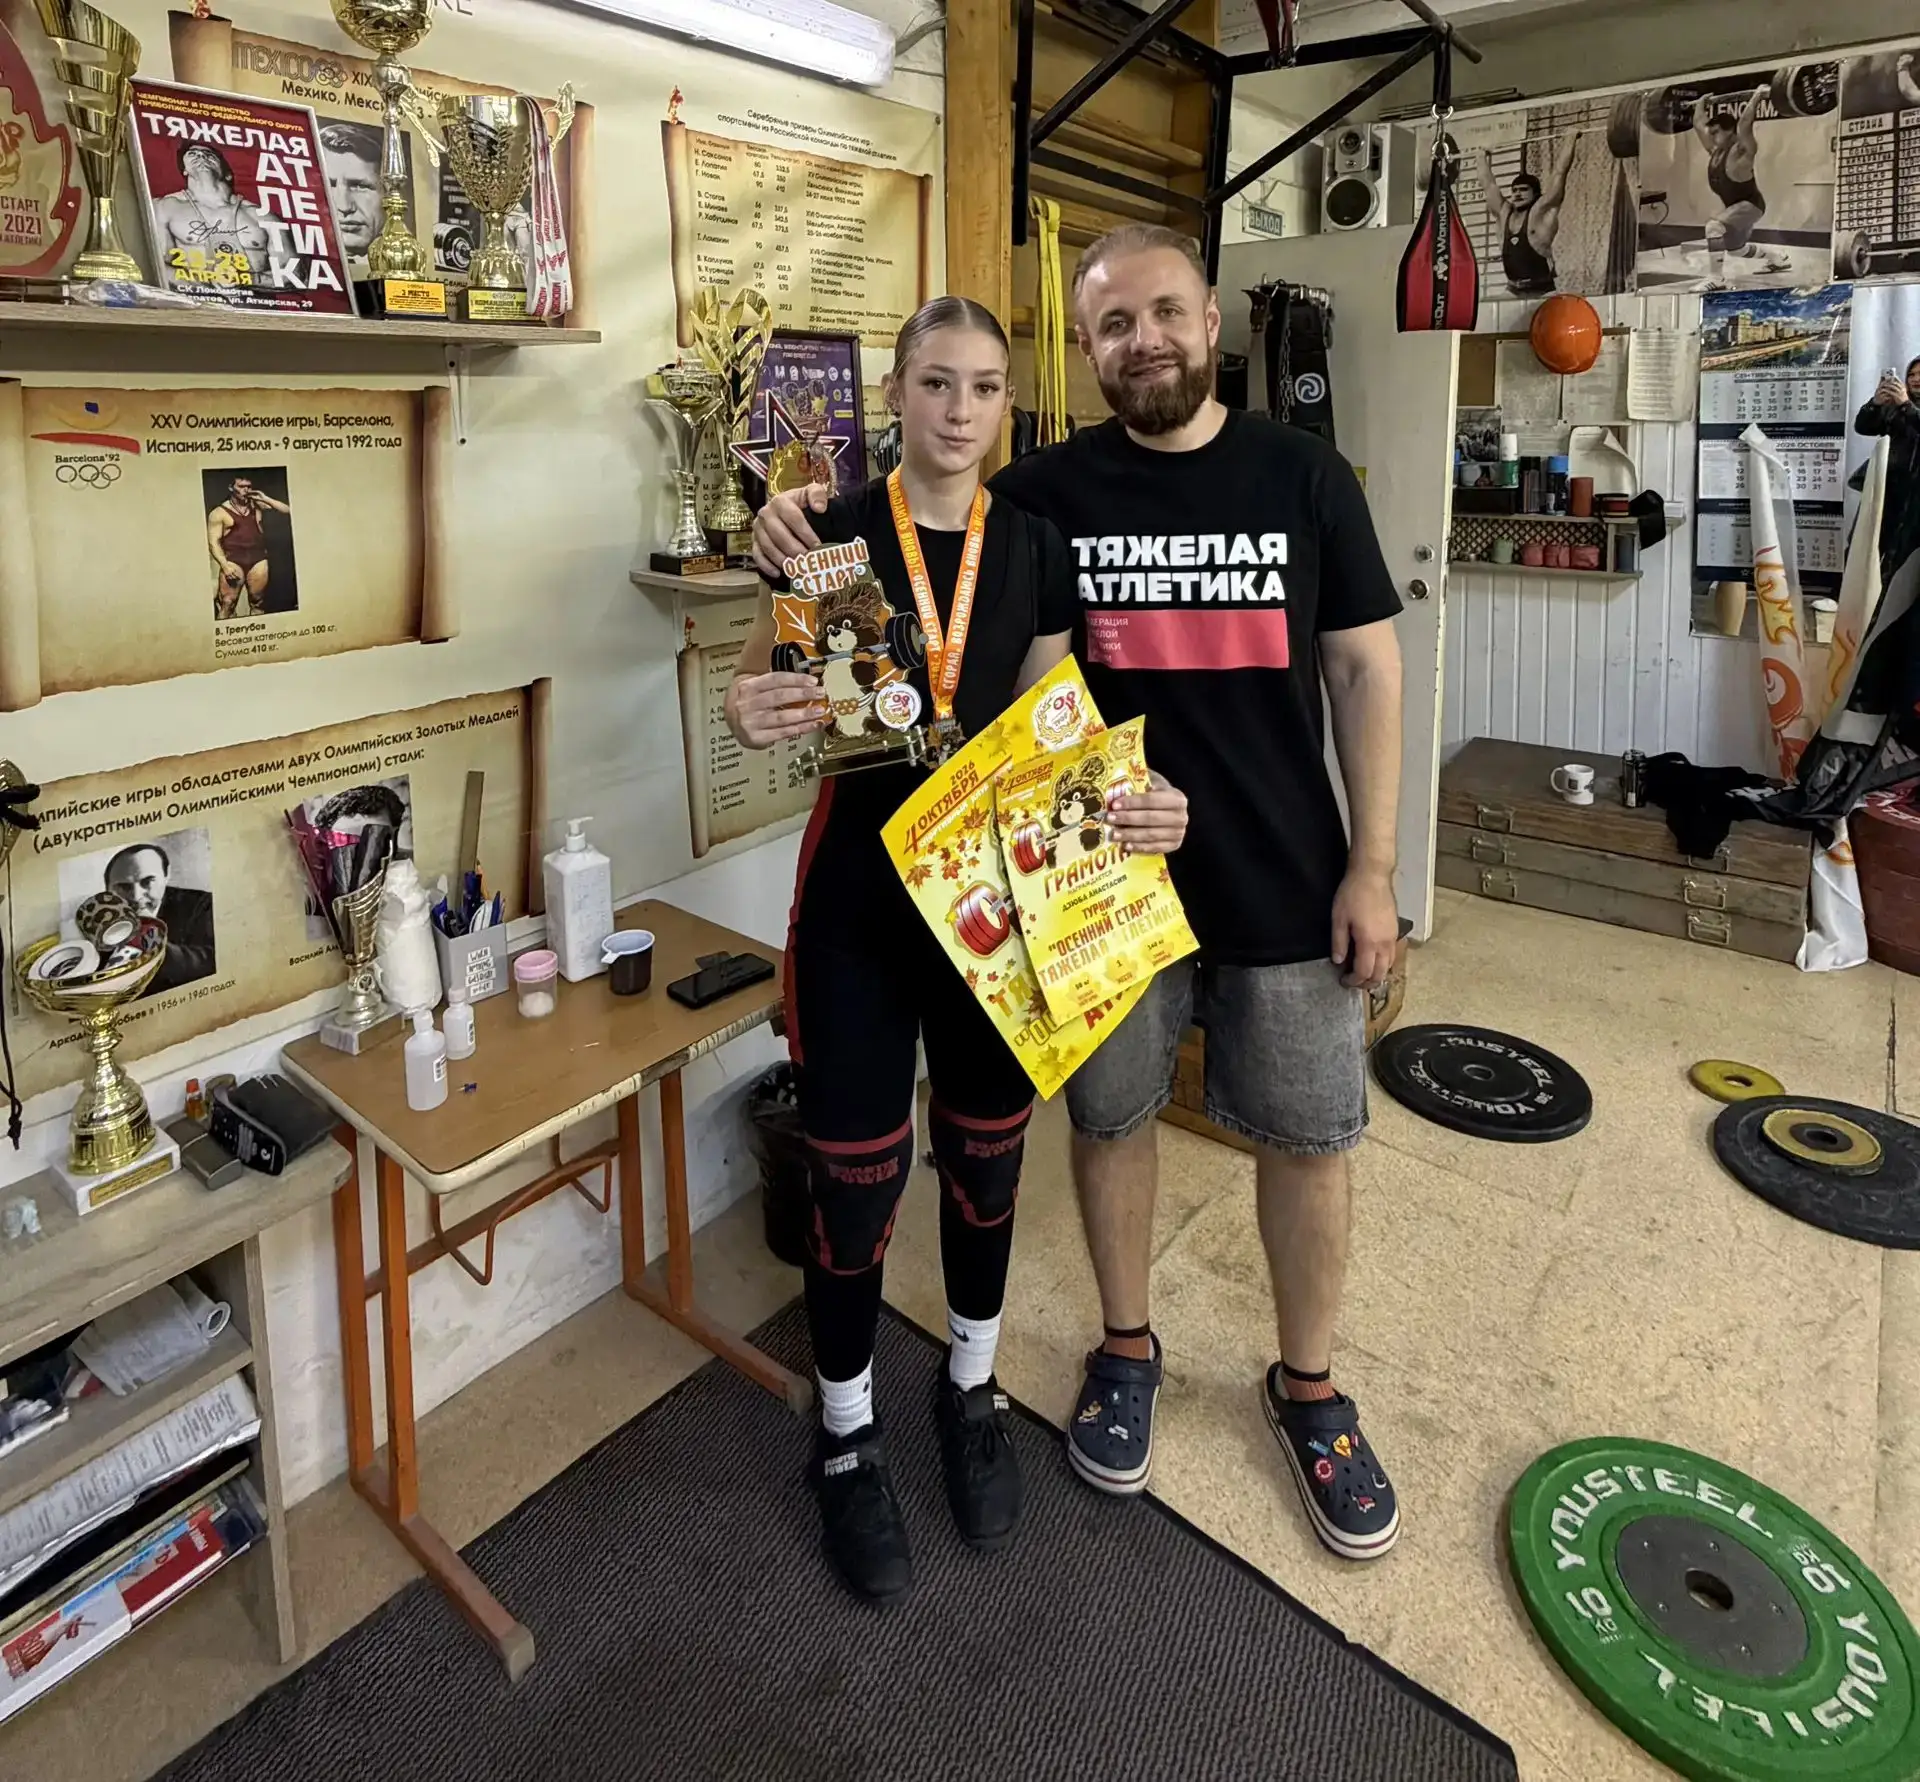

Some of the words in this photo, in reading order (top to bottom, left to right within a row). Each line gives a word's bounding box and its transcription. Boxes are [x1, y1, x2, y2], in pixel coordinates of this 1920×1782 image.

[137, 92, 190, 106] ЧЕМПИОНАТ
[199, 102, 251, 117] ПЕРВЕНСТВО
[281, 80, 340, 103] Мехико,
[138, 100, 210, 117] ПРИВОЛЖСКОГО
[212, 111, 274, 127] ФЕДЕРАЛЬНОГО
[275, 122, 305, 132] ОКРУГА
[718, 114, 761, 131] спортсмены
[770, 125, 810, 142] Российской
[1848, 117, 1884, 133] СТРАНА
[141, 112, 310, 157] ТЯЖЕЛАЯ
[255, 153, 312, 188] АТ
[701, 150, 732, 162] Саксонов
[1, 196, 41, 213] СТАРТ
[256, 186, 320, 222] ЛЕ
[704, 191, 725, 201] Стогов
[4, 214, 42, 235] 2021
[1249, 206, 1283, 236] ВЫХОД
[1436, 190, 1447, 255] WORKOUT
[258, 221, 328, 256] ТИ
[269, 256, 344, 292] КА
[177, 284, 194, 293] СК
[196, 286, 254, 296] Локомотив
[229, 298, 243, 306] ул.
[246, 299, 300, 309] Аткарская,
[302, 300, 313, 308] 29
[151, 413, 182, 429] XXV
[185, 413, 284, 429] Олимпийские
[286, 414, 320, 430] игры,
[323, 412, 395, 430] Барселона,
[146, 438, 214, 454] Испания,
[217, 437, 233, 451] 25
[236, 438, 271, 451] июля
[282, 435, 289, 449] 9
[292, 437, 343, 453] августа
[346, 434, 373, 447] 1992
[374, 436, 402, 450] года
[784, 539, 869, 578] ОСЕННИЙ
[1071, 533, 1288, 567] ТЯЖЕЛАЯ
[802, 566, 859, 595] СТАРТ
[1077, 570, 1286, 602] АТЛЕТИКА
[913, 574, 933, 620] ОСЕННИЙ
[951, 570, 975, 645] ВОЗРОЖДАЮСЬ
[215, 627, 223, 635] В.
[226, 622, 266, 635] Трегубов
[215, 636, 252, 648] Весовая
[254, 630, 297, 643] категория
[299, 628, 311, 637] до
[312, 624, 326, 634] 100
[215, 649, 249, 660] Сумма
[251, 643, 267, 653] 410
[126, 784, 167, 805] игры
[171, 760, 285, 794] обладателями
[288, 750, 321, 768] двух
[324, 731, 413, 760] Олимпийских
[415, 719, 466, 740] Золотых
[468, 705, 519, 727] Медалей
[33, 810, 162, 854] (двукратными
[166, 779, 285, 818] Олимпийскими
[288, 758, 382, 790] Чемпионами)
[384, 749, 425, 768] стали:
[918, 770, 979, 830] ОКТЯБРЯ
[1088, 873, 1128, 899] АНАСТАСИЯ
[1082, 894, 1116, 920] ТУРНИР
[289, 948, 324, 966] Василий
[1038, 938, 1110, 987] ТЯЖЕЛАЯ
[157, 998, 178, 1011] 1956
[188, 986, 209, 1001] 1960
[210, 978, 237, 996] годах
[1550, 1464, 1773, 1571] YOUSTEEL
